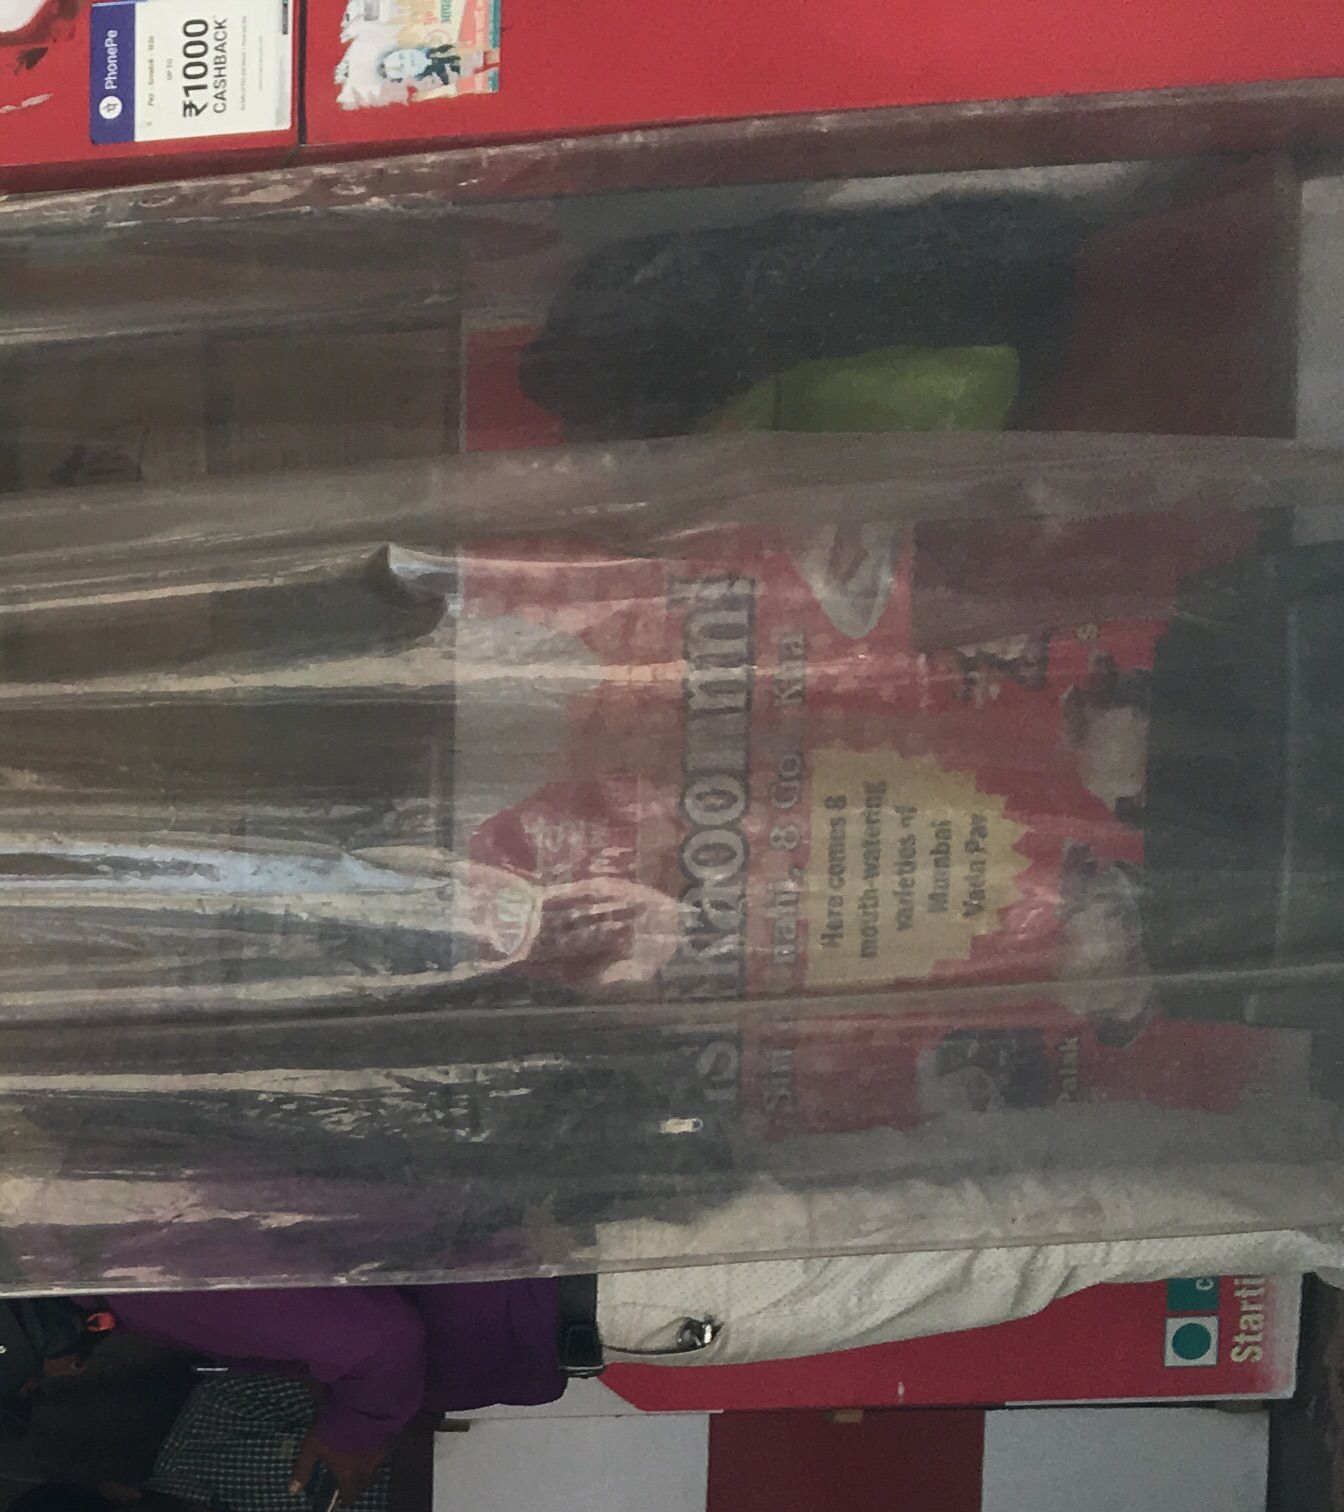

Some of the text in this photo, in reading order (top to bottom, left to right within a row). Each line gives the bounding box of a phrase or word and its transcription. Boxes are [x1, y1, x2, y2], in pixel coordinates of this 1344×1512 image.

[104, 29, 119, 90] PhonePe
[181, 18, 209, 118] ₹1000
[213, 18, 228, 114] CASHBACK
[769, 824, 801, 850] 8
[826, 817, 847, 890] comes
[857, 780, 887, 959] mouth-watering
[891, 834, 916, 932] varieties
[926, 820, 952, 913] Mumbai
[961, 813, 988, 919] Vada Pav
[819, 895, 844, 948] Here
